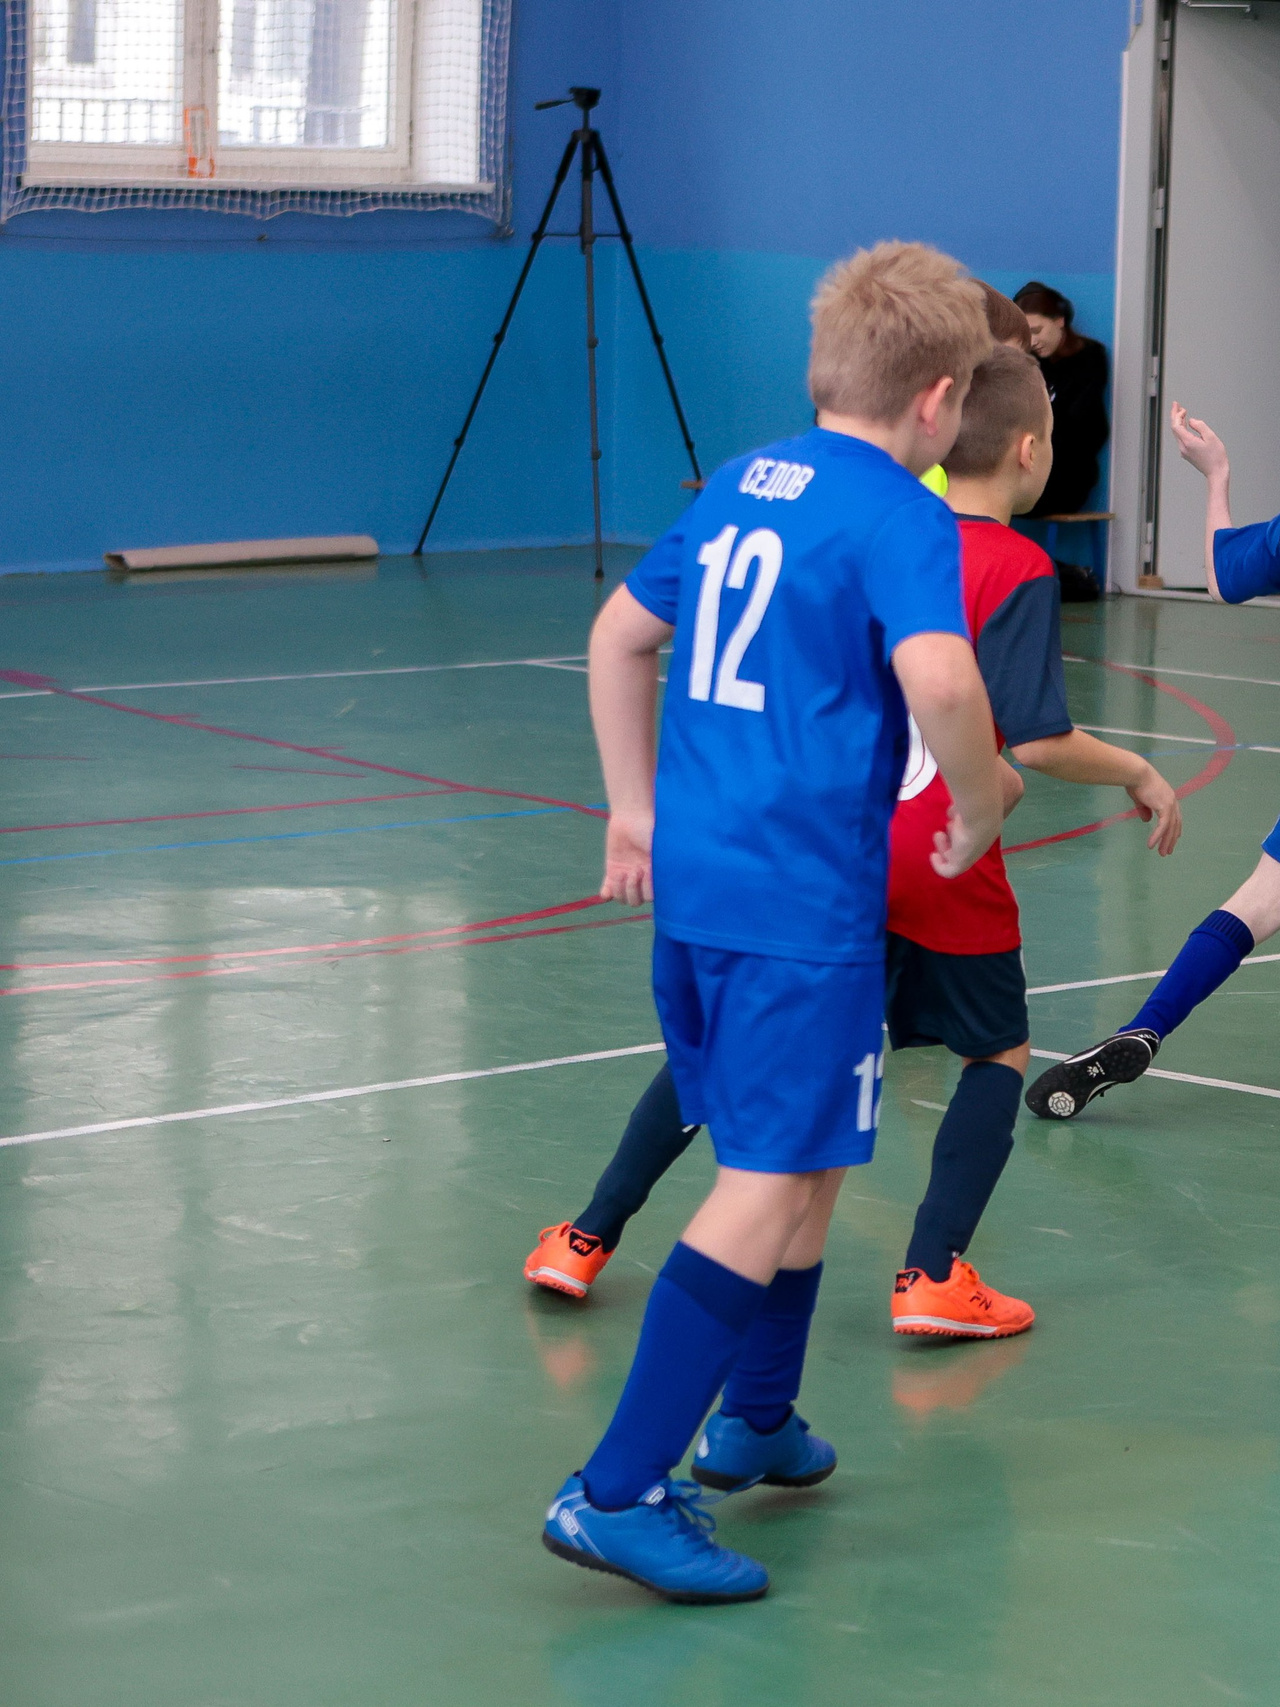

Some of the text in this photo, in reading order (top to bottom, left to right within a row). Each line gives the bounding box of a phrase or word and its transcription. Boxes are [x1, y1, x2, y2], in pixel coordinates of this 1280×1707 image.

[739, 458, 814, 501] СЕДОВ
[692, 524, 783, 712] 12
[969, 1291, 992, 1310] FN
